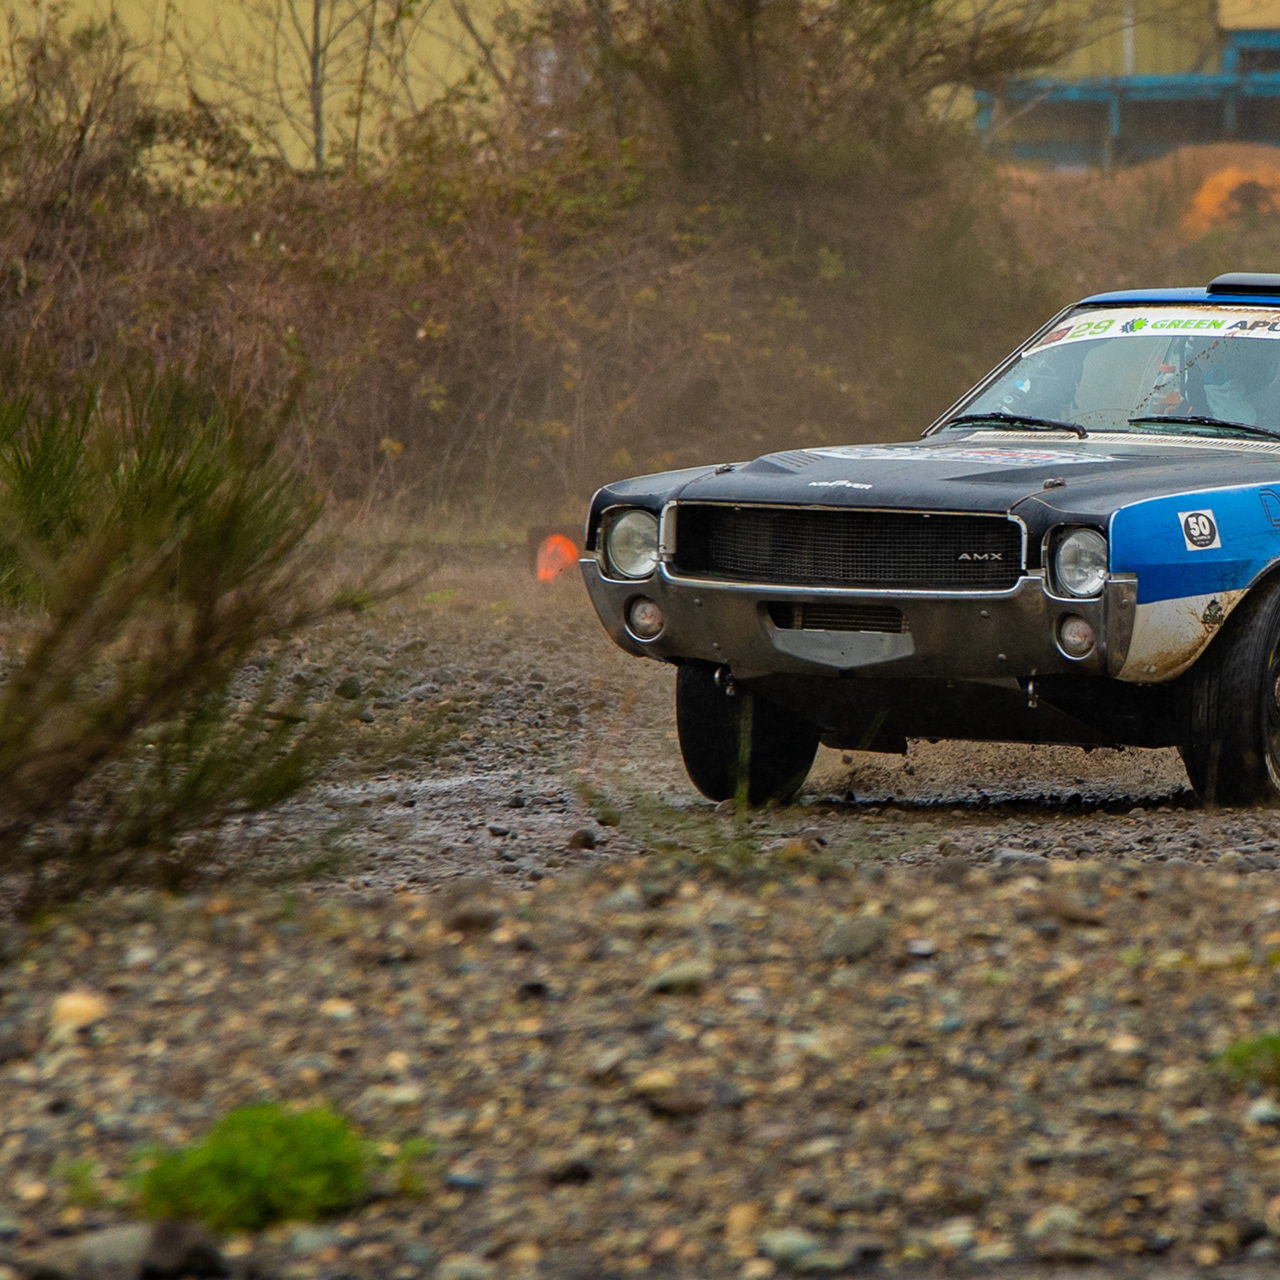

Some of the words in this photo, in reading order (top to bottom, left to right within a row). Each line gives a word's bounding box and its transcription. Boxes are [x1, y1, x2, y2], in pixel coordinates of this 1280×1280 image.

[1067, 319, 1116, 340] 29
[1151, 319, 1227, 330] GREEN
[1187, 515, 1211, 537] 50
[958, 552, 1003, 561] AMX
